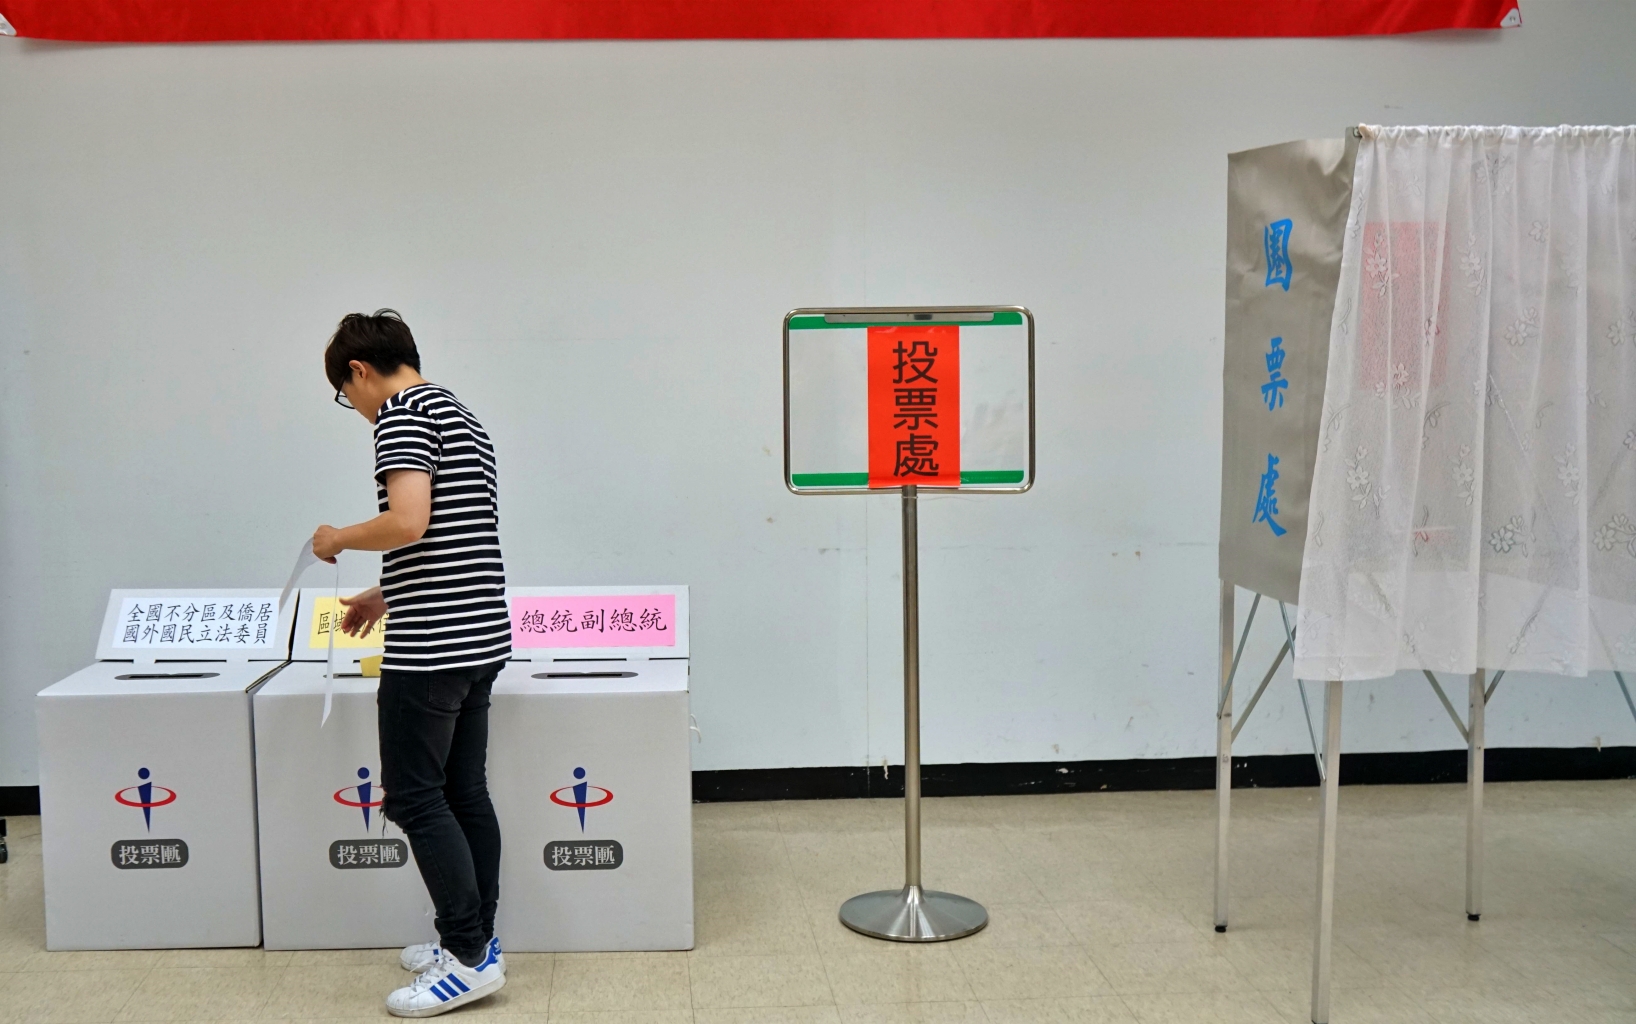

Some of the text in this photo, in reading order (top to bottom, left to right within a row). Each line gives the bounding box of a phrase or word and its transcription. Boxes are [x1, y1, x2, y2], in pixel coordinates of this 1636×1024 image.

[892, 340, 940, 478] 投票處
[127, 602, 273, 622] 全國不分區及僑居
[519, 607, 668, 634] 總統副總統
[122, 623, 268, 644] 國外國民立法委員
[118, 843, 182, 866] 投票匭
[337, 843, 401, 866] 投票匭
[551, 844, 616, 867] 投票匭
